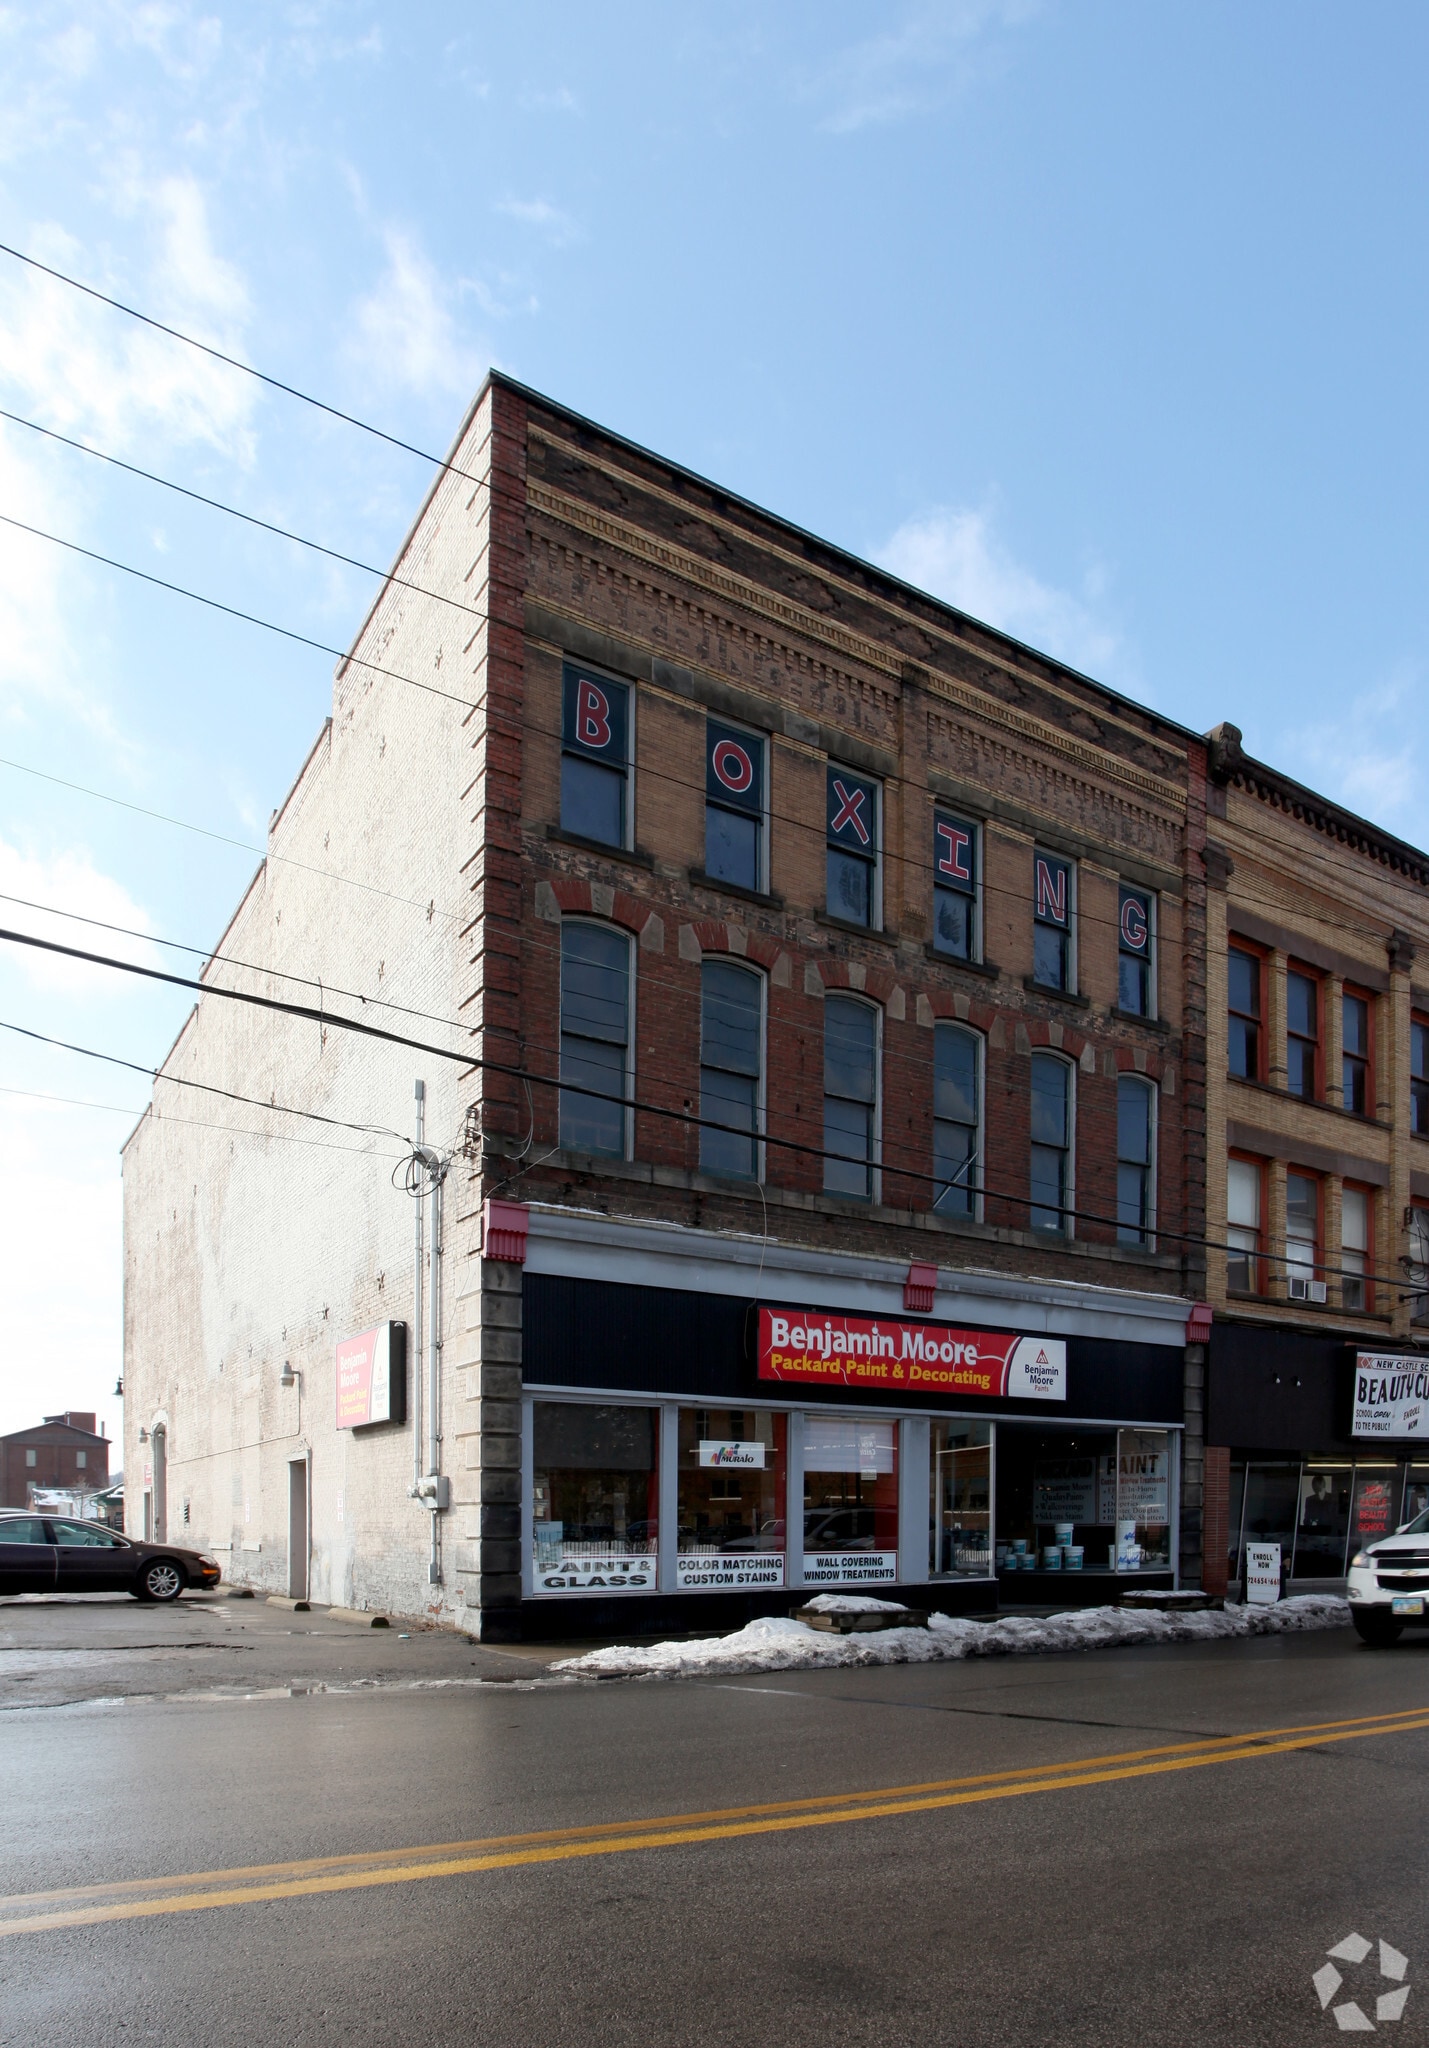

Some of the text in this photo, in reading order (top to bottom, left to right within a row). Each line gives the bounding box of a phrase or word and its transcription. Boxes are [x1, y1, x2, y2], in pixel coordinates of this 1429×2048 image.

[772, 1317, 978, 1365] Benjamin Moore
[340, 1348, 367, 1372] Benjamin
[1377, 1360, 1394, 1369] NEW
[1396, 1361, 1418, 1371] CASTLE
[771, 1353, 991, 1390] Packard Paint & Decorating
[1025, 1364, 1059, 1376] Benjamin
[340, 1372, 360, 1389] Moore
[1029, 1374, 1054, 1386] Moore
[1356, 1409, 1391, 1419] SCHOOL OPEN
[1403, 1404, 1421, 1421] ENROLL
[1355, 1421, 1362, 1431] TO
[1362, 1421, 1371, 1431] THE
[1407, 1419, 1419, 1431] NOW
[1106, 1454, 1159, 1475] PAINT
[1128, 1485, 1157, 1493] In-Home
[1359, 1510, 1388, 1520] BEAUTY
[1358, 1521, 1387, 1533] SCHOOL
[816, 1556, 884, 1568] WALL COVERING
[1252, 1553, 1273, 1561] ENROLL
[538, 1560, 652, 1573] PAINT &
[679, 1558, 783, 1571] COLOR MATCHING
[1257, 1561, 1270, 1569] NOW
[684, 1572, 778, 1585] CUSTOM STAINS
[804, 1568, 895, 1580] WINDOW TREATMENTS
[543, 1574, 648, 1588] GLASS
